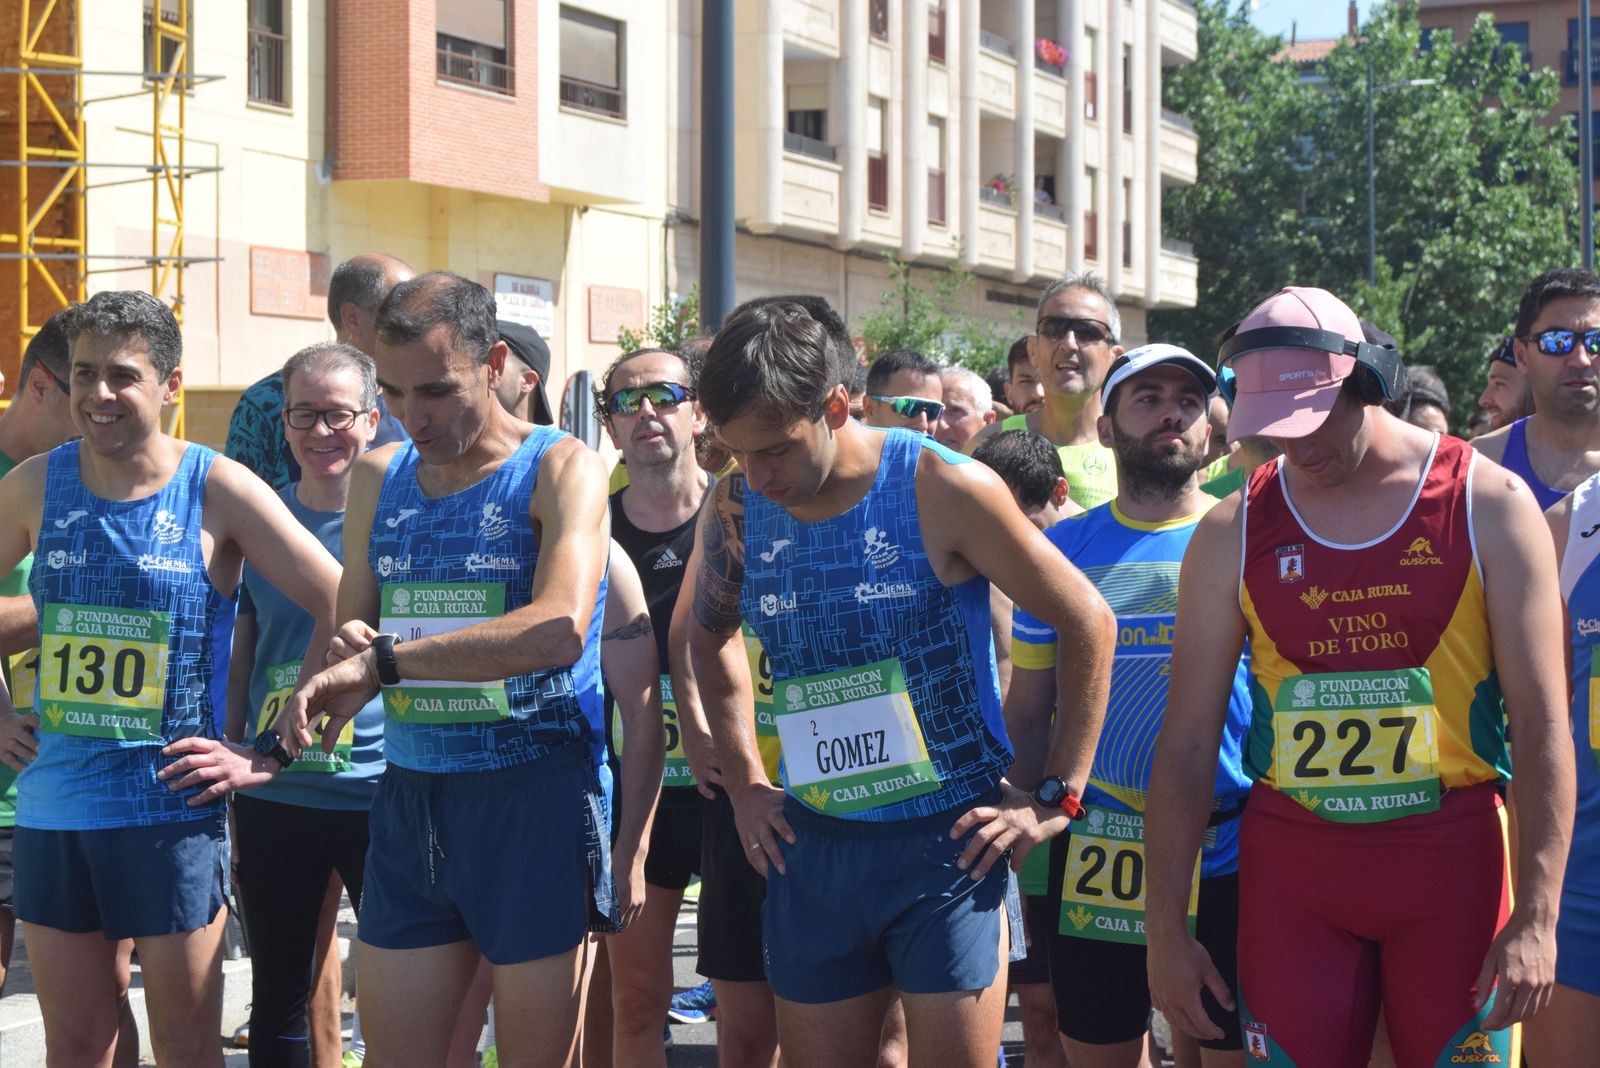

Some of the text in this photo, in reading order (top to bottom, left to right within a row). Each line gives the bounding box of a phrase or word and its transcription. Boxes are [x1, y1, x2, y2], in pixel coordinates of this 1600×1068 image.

[653, 558, 683, 570] adidas
[413, 589, 487, 602] FUNDACION
[1332, 584, 1411, 602] CAJA RURAL
[413, 602, 487, 614] CAJA RURAL
[76, 610, 152, 629] FUNDACION
[1328, 612, 1387, 634] VINO
[76, 622, 151, 639] CAJA RURAL
[1308, 631, 1409, 657] DE TORO
[53, 643, 146, 698] 130
[806, 669, 883, 694] FUNDACION
[1319, 677, 1409, 692] FUNDACION
[808, 682, 886, 708] CAJA RURAL
[1319, 691, 1411, 707] CAJA RURAL
[414, 698, 499, 712] CAJA RURAL
[65, 712, 151, 730] CAJA RURAL
[810, 720, 819, 737] 2
[816, 730, 890, 774] GOMEZ
[1292, 715, 1417, 778] 227
[832, 772, 928, 802] CAJA RURAL
[1324, 791, 1430, 812] CAJA RURAL
[1107, 825, 1135, 838] CAJA
[1095, 916, 1131, 932] CAJA
